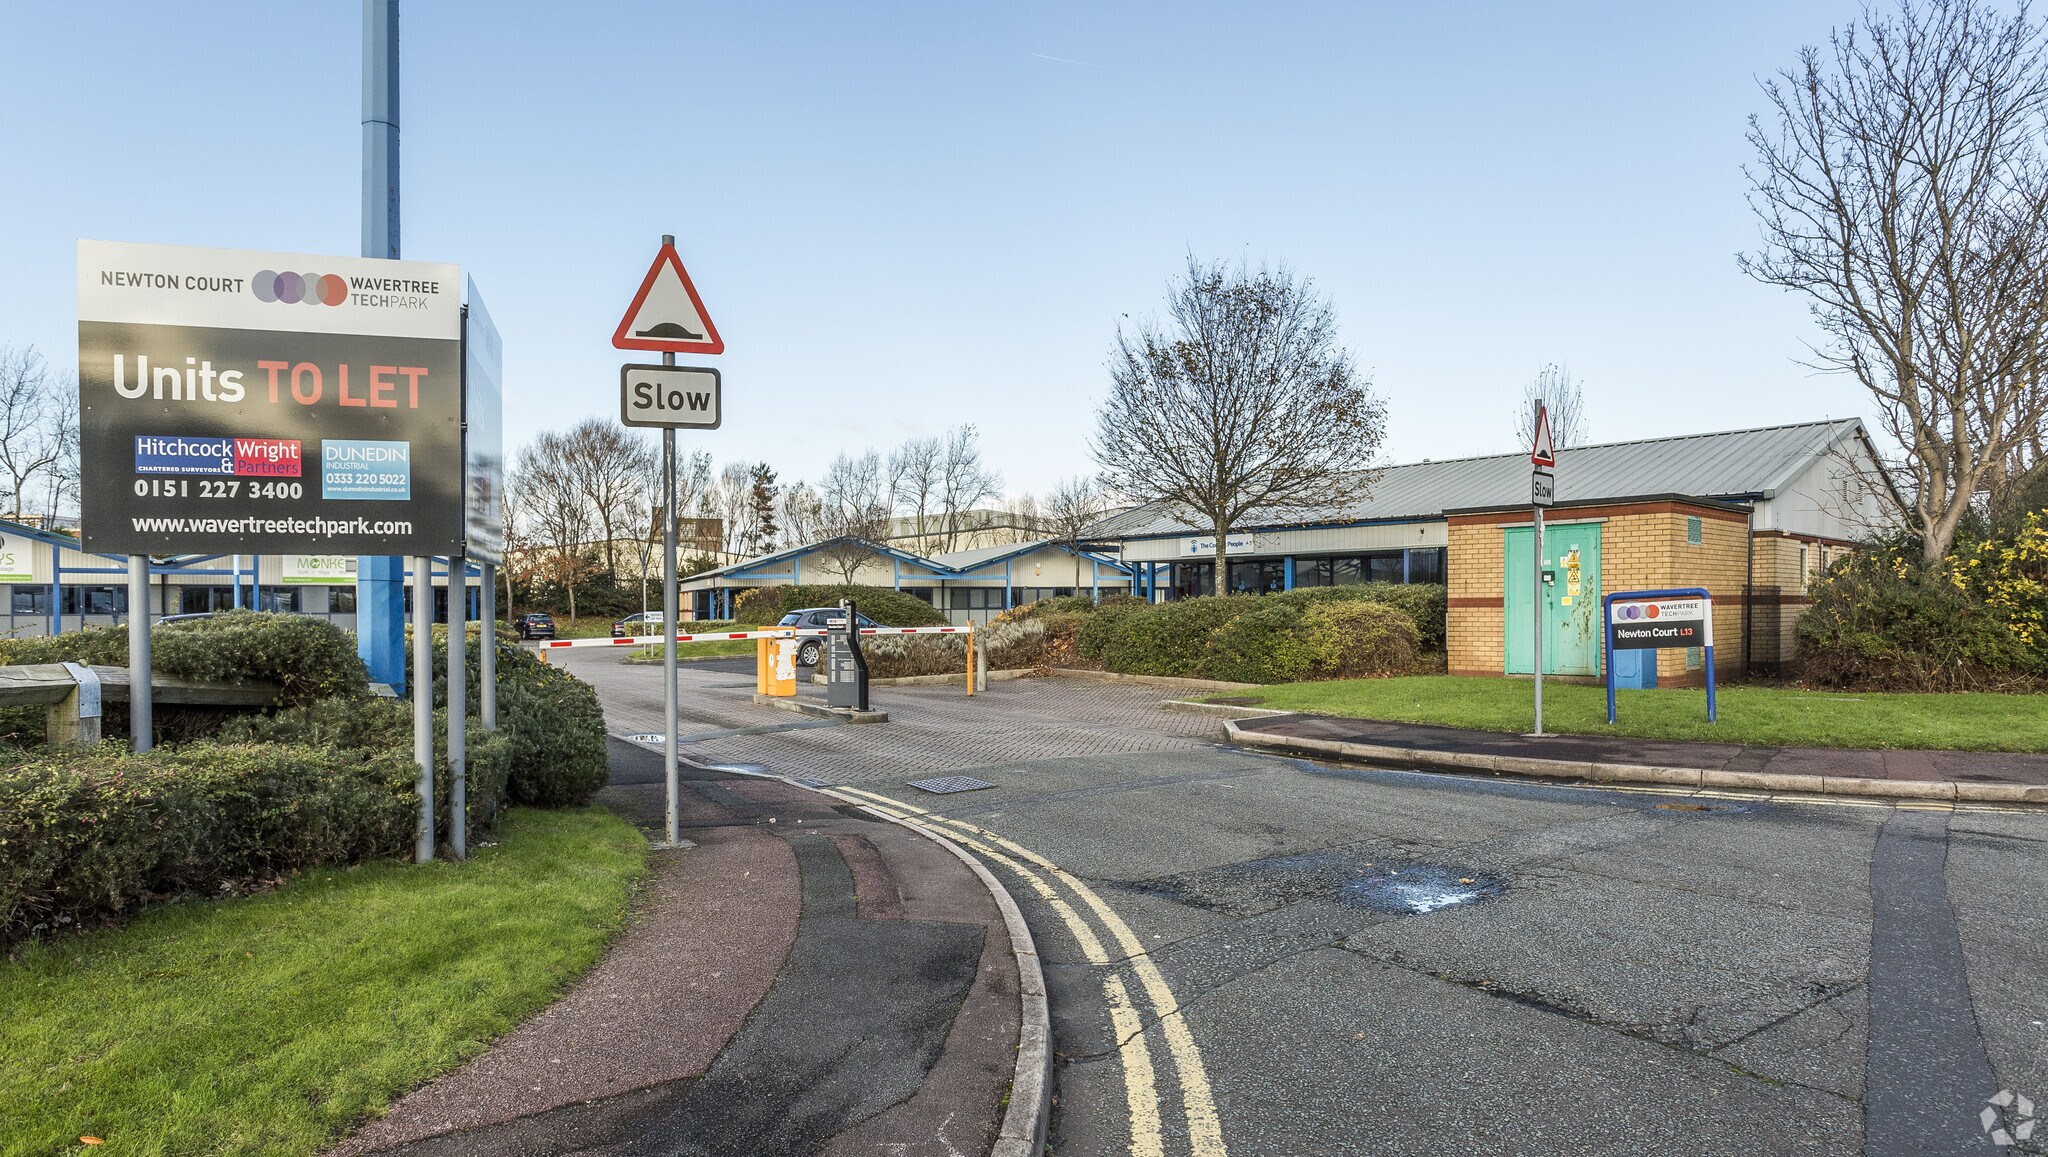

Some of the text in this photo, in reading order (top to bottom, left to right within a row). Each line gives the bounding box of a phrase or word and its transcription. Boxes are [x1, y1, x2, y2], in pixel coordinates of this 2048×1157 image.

[101, 270, 244, 293] NEWTON COURT
[350, 276, 439, 294] WAVERTREE
[350, 293, 428, 310] TECHPARK
[113, 353, 246, 402] Units
[257, 360, 323, 405] TO
[338, 363, 429, 409] LET
[632, 382, 711, 412] Slow
[137, 437, 299, 463] Hitchcock Wright
[326, 446, 407, 463] DUNEDIN
[138, 465, 221, 474] CHARTERED SURVEYORS
[221, 457, 299, 475] & Partners
[326, 462, 370, 471] INDUSTRIAL
[326, 473, 406, 486] 0333 220 5022
[134, 479, 303, 500] 0151 227 3400
[1535, 481, 1551, 498] Slow
[132, 516, 412, 538] www.wavertreetechpark.com
[1660, 603, 1699, 611] WAVERTREE
[1617, 627, 1694, 638] Newton Court L13
